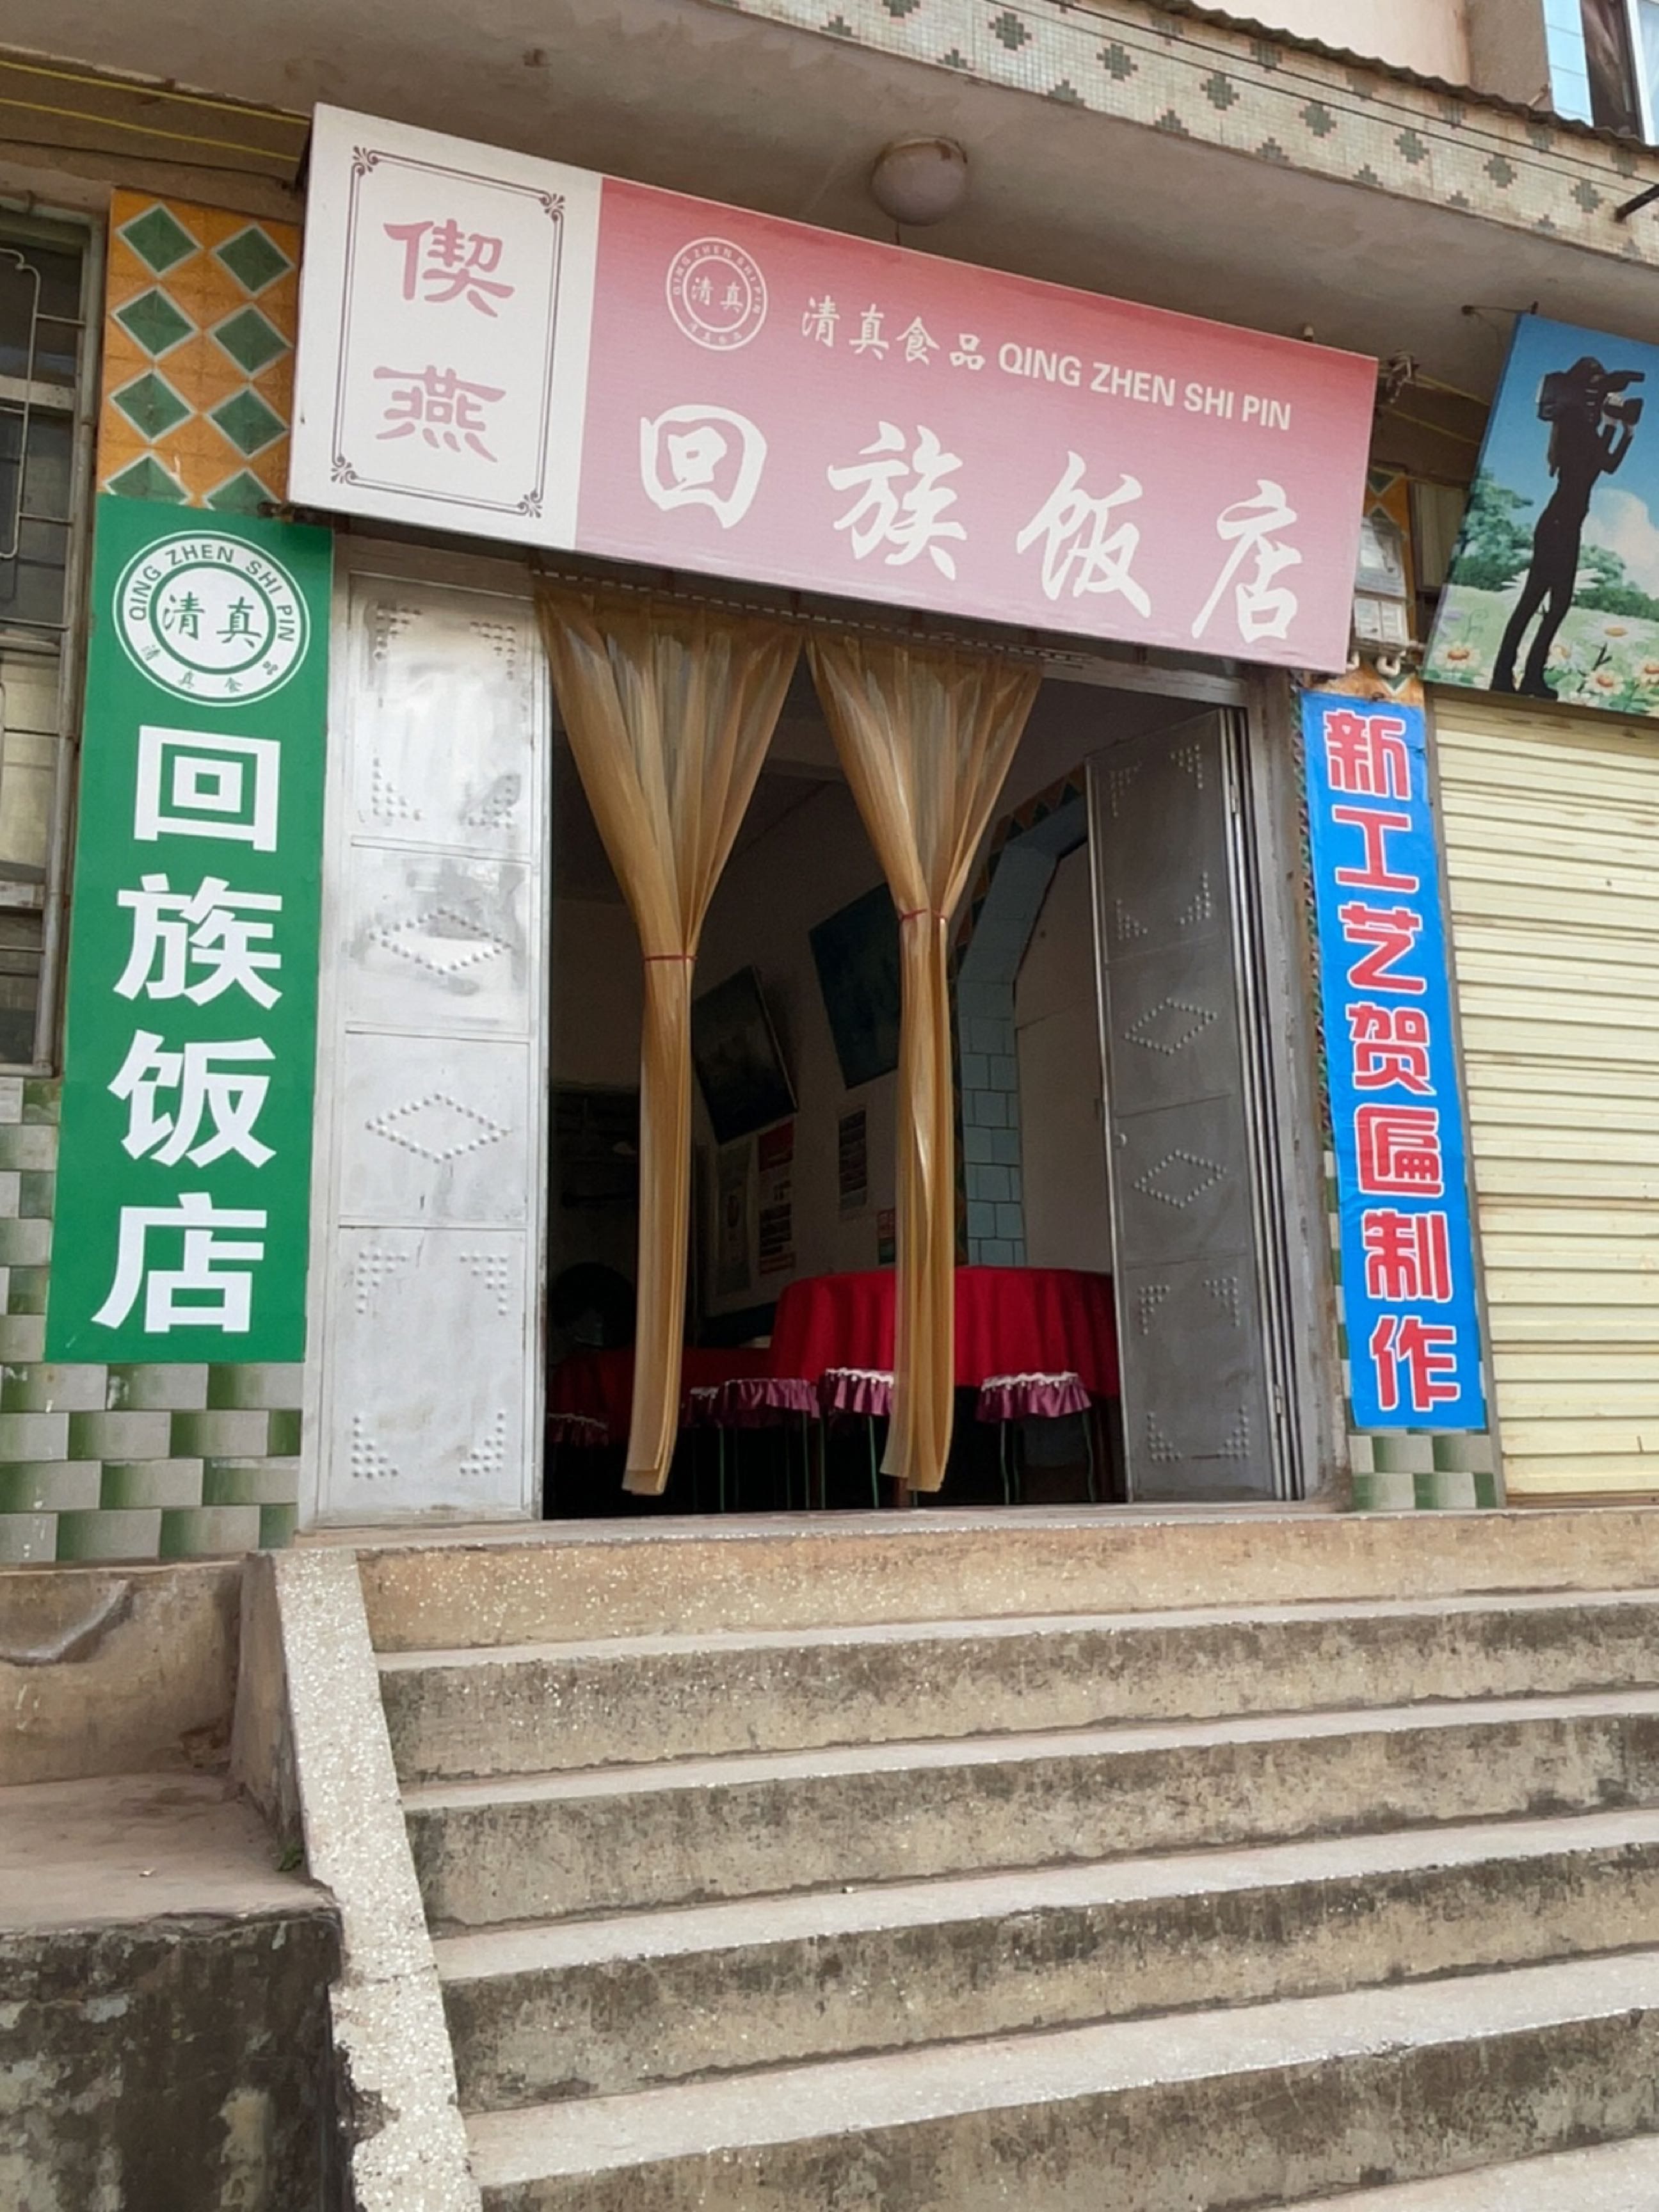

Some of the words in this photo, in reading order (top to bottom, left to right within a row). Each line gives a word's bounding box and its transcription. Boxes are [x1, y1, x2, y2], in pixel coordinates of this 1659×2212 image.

[691, 276, 744, 314] 清真
[801, 295, 984, 371] 清真食品
[998, 342, 1082, 388] QING
[1091, 363, 1176, 406] ZHEN
[1184, 383, 1234, 420] SHI
[1242, 394, 1292, 431] PIN
[640, 404, 1303, 643] 回族饭店
[129, 566, 161, 621] QING
[165, 545, 234, 566] ZHEN
[245, 561, 284, 595] SHI
[276, 605, 295, 642] PIN
[162, 591, 262, 648] 清真
[92, 725, 282, 1333] 回族饭店
[1322, 709, 1461, 1413] 新工艺贺匾制作
